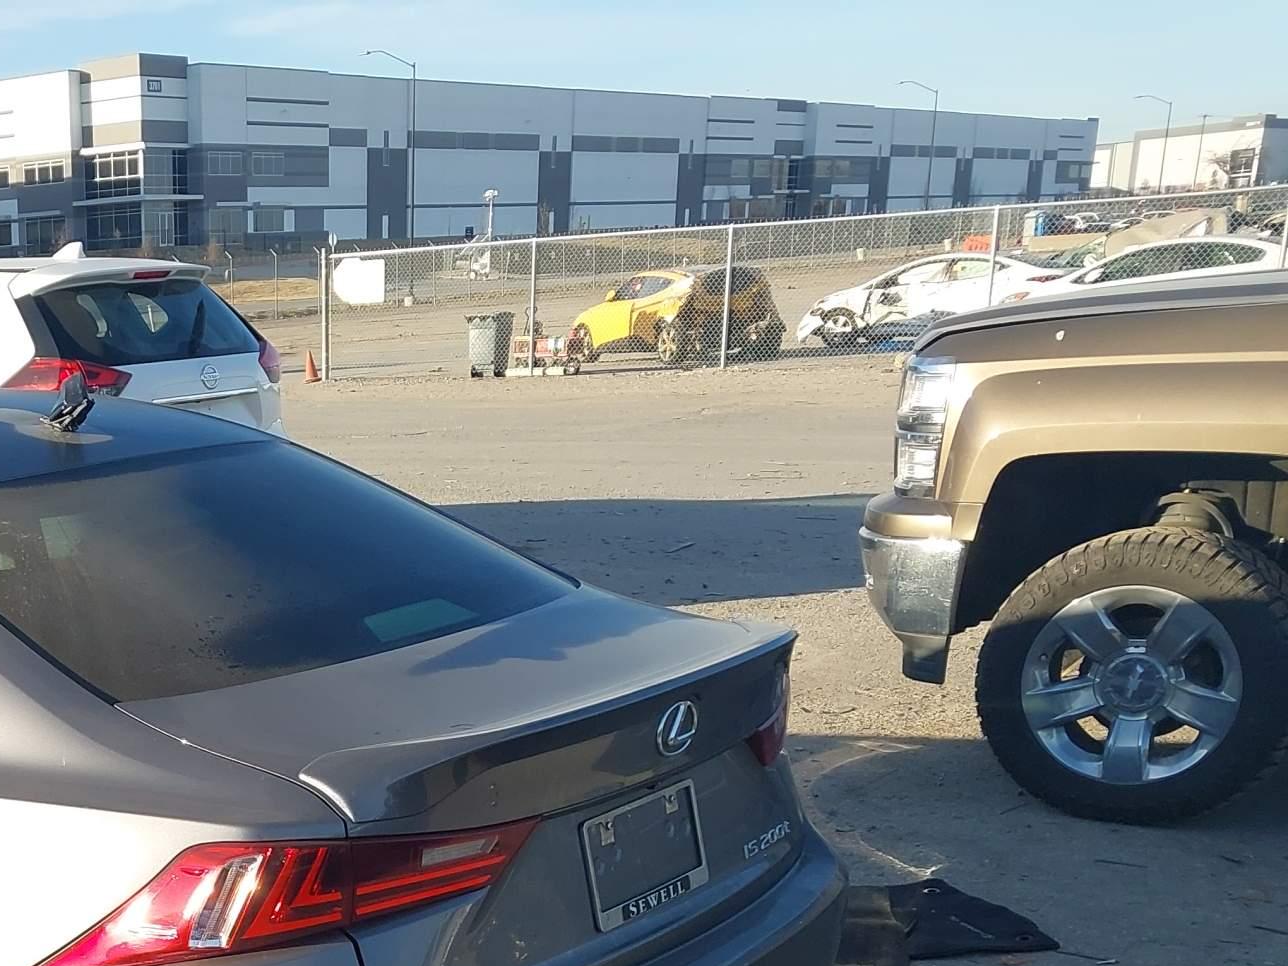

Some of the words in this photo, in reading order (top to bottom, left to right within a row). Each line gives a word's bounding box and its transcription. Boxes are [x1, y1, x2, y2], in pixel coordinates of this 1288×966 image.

[743, 839, 759, 859] IS
[759, 820, 791, 850] 200t
[628, 880, 686, 918] SEWELL
